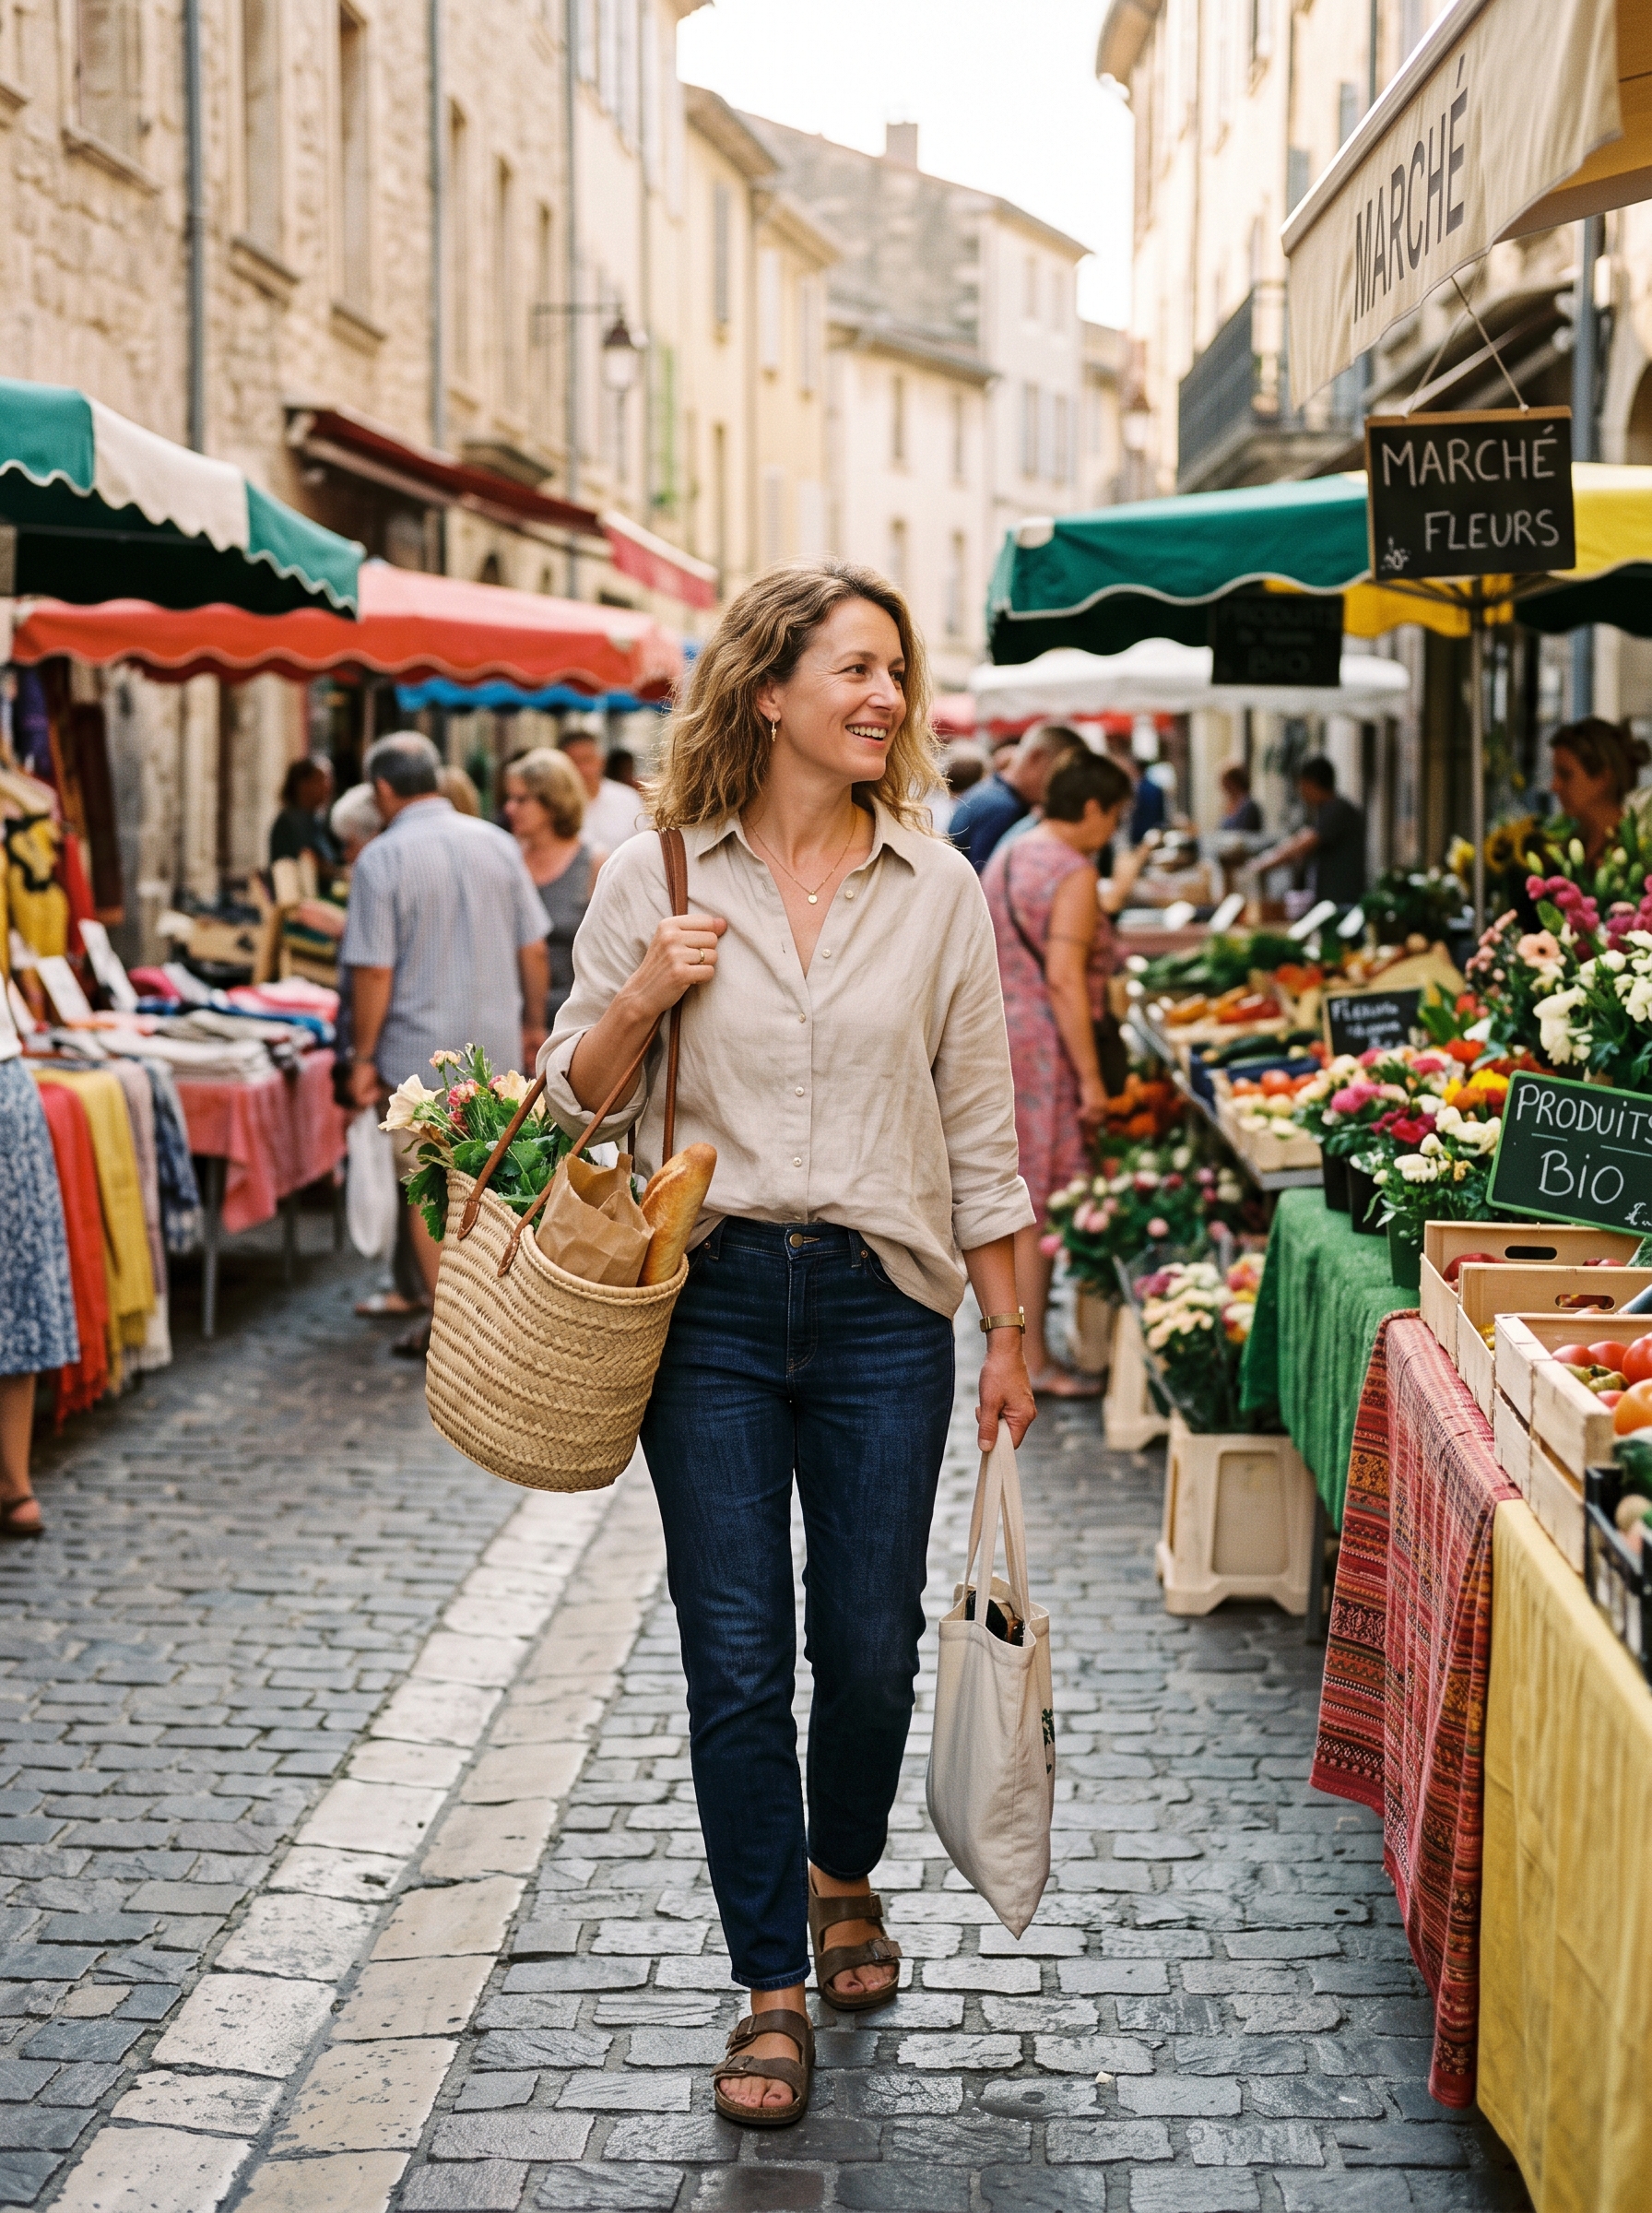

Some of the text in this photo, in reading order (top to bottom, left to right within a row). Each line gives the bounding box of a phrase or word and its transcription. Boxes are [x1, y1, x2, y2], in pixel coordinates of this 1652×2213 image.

[1354, 53, 1468, 323] MARCHÉ
[1382, 424, 1558, 487] MARCHÉ
[1424, 509, 1560, 551] FLEURS
